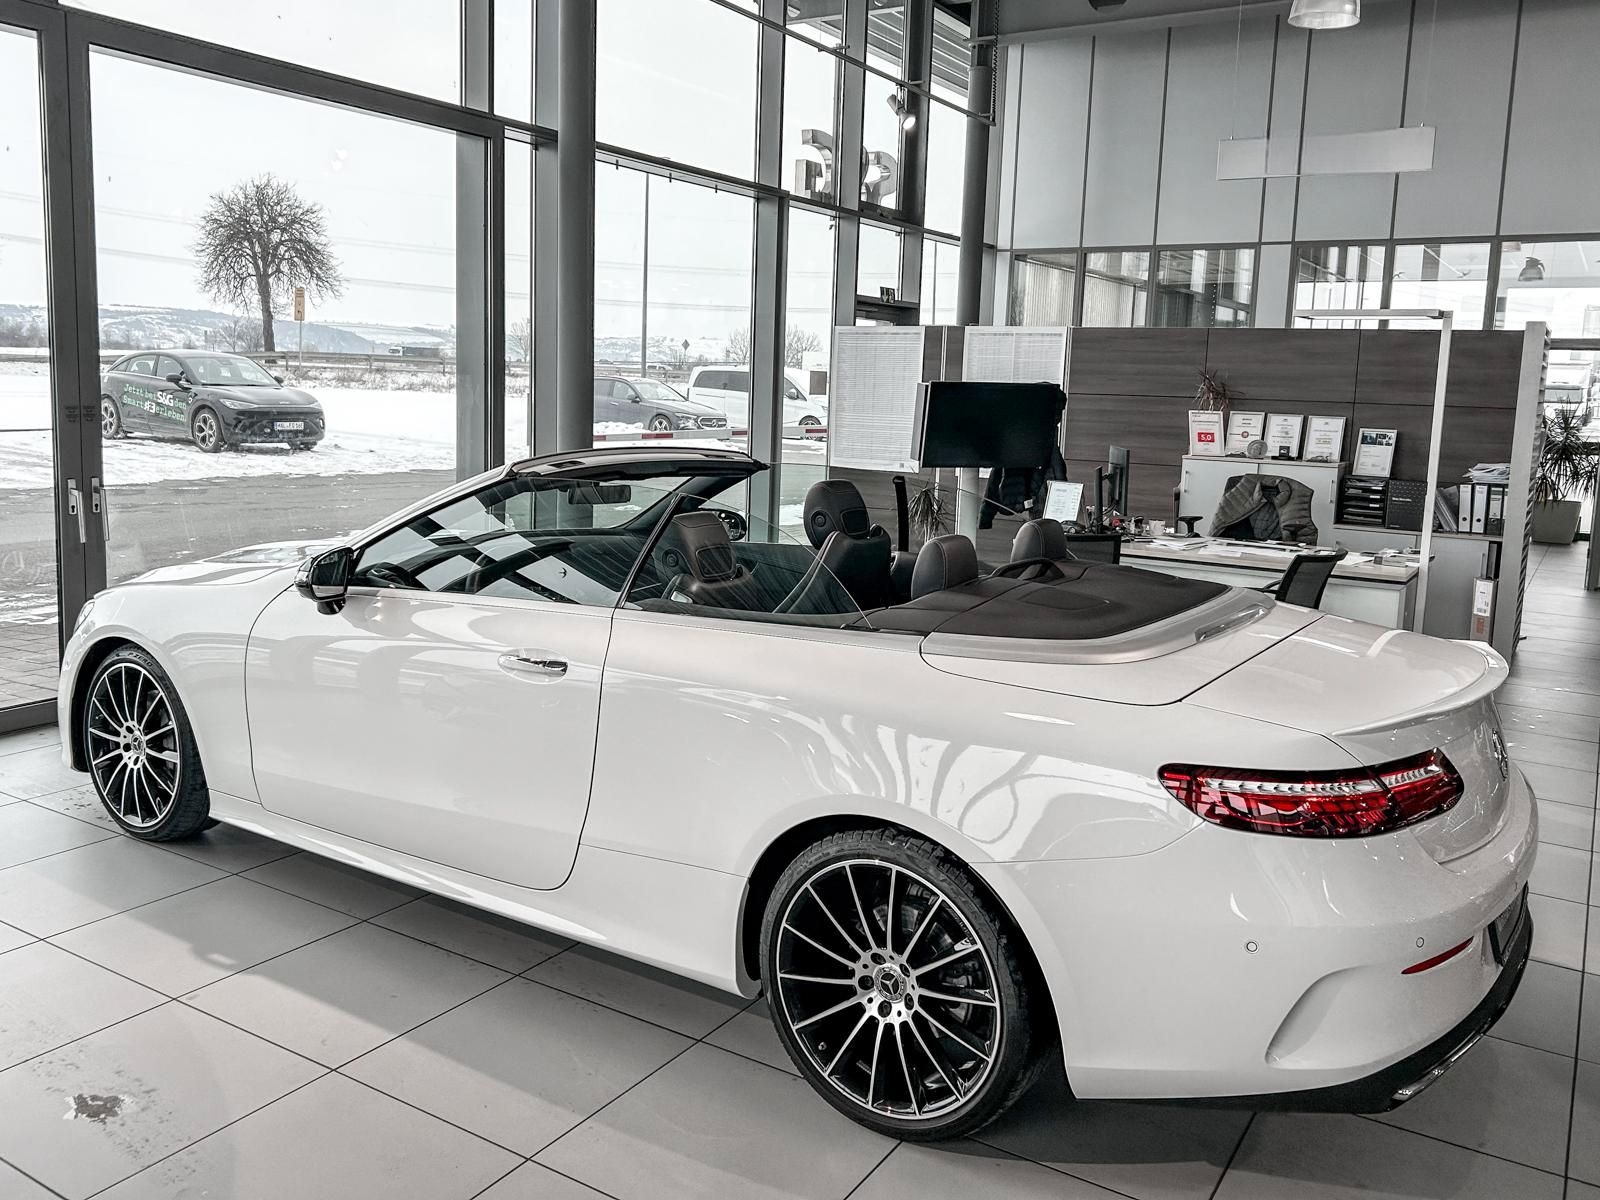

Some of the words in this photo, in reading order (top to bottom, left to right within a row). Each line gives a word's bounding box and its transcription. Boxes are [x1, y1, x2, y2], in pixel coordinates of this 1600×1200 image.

[122, 394, 144, 409] Smart
[144, 400, 156, 413] #3
[155, 406, 187, 422] erleben.
[124, 383, 144, 397] Jetzt
[144, 389, 157, 401] bei
[157, 391, 174, 407] S&G
[174, 397, 187, 410] den
